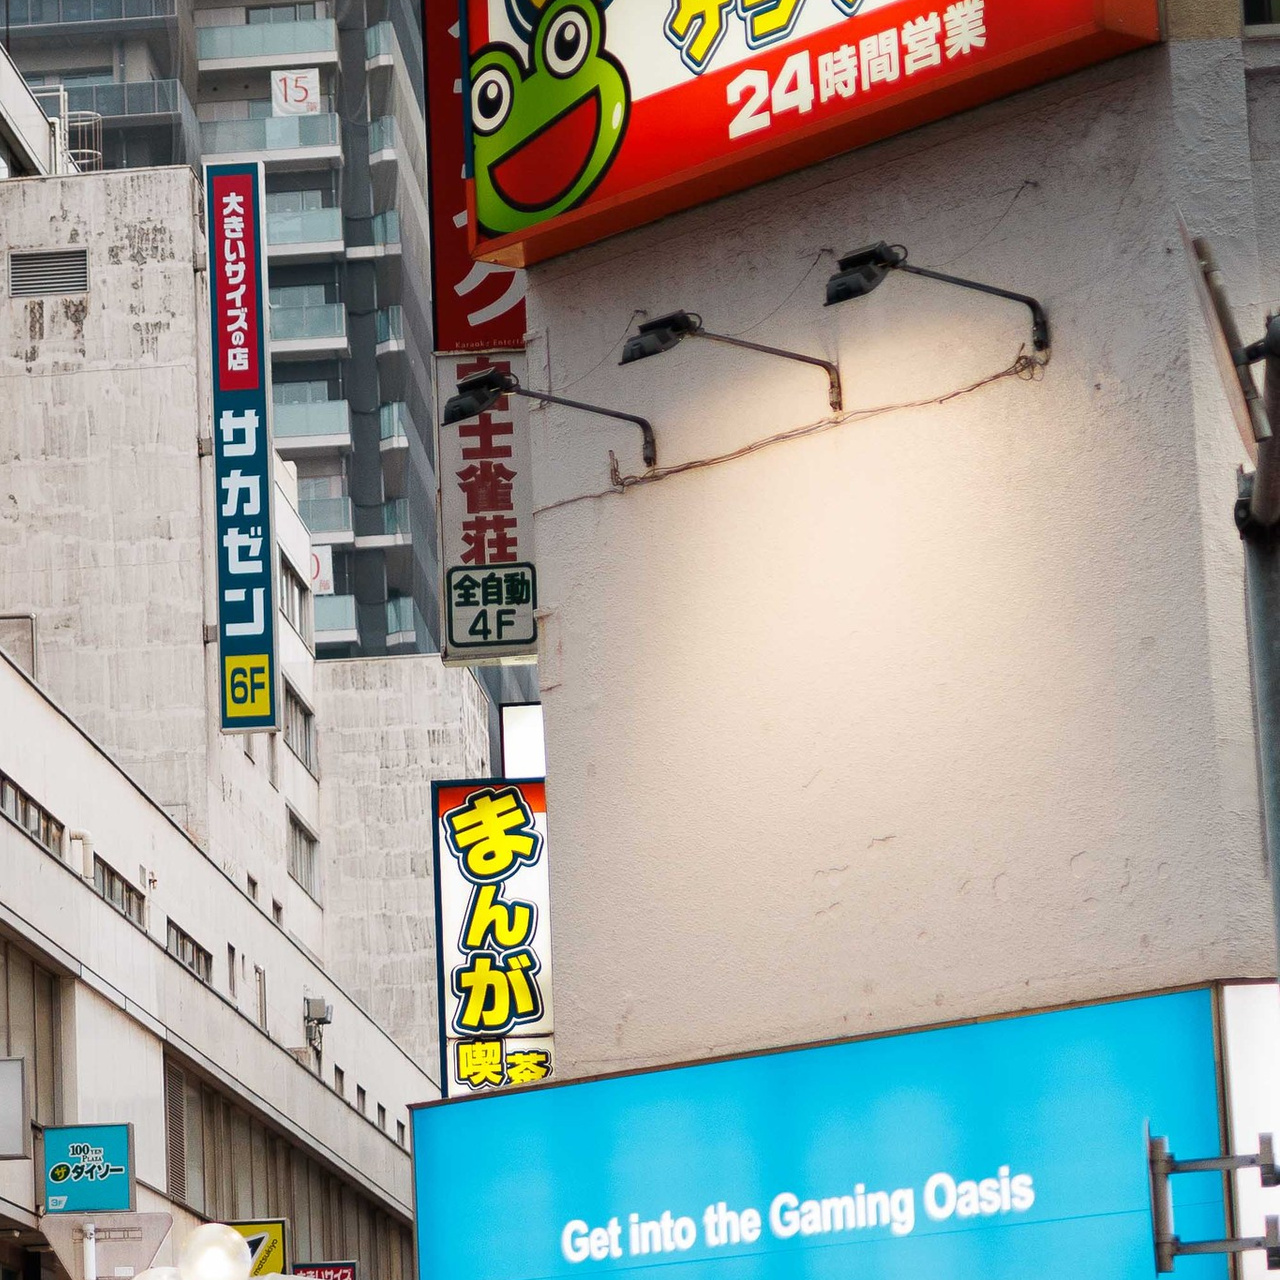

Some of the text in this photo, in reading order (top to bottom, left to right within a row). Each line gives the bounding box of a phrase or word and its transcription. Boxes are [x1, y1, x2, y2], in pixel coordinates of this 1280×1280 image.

[222, 191, 250, 372] 大きいサイズの店
[220, 408, 265, 637] サカゼン
[453, 572, 531, 608] 全自動
[467, 608, 517, 641] 4F
[230, 666, 266, 706] 6F
[445, 787, 542, 1034] まんが
[70, 1144, 89, 1156] 100
[561, 1165, 1035, 1263] Get into the Gaming Oasis
